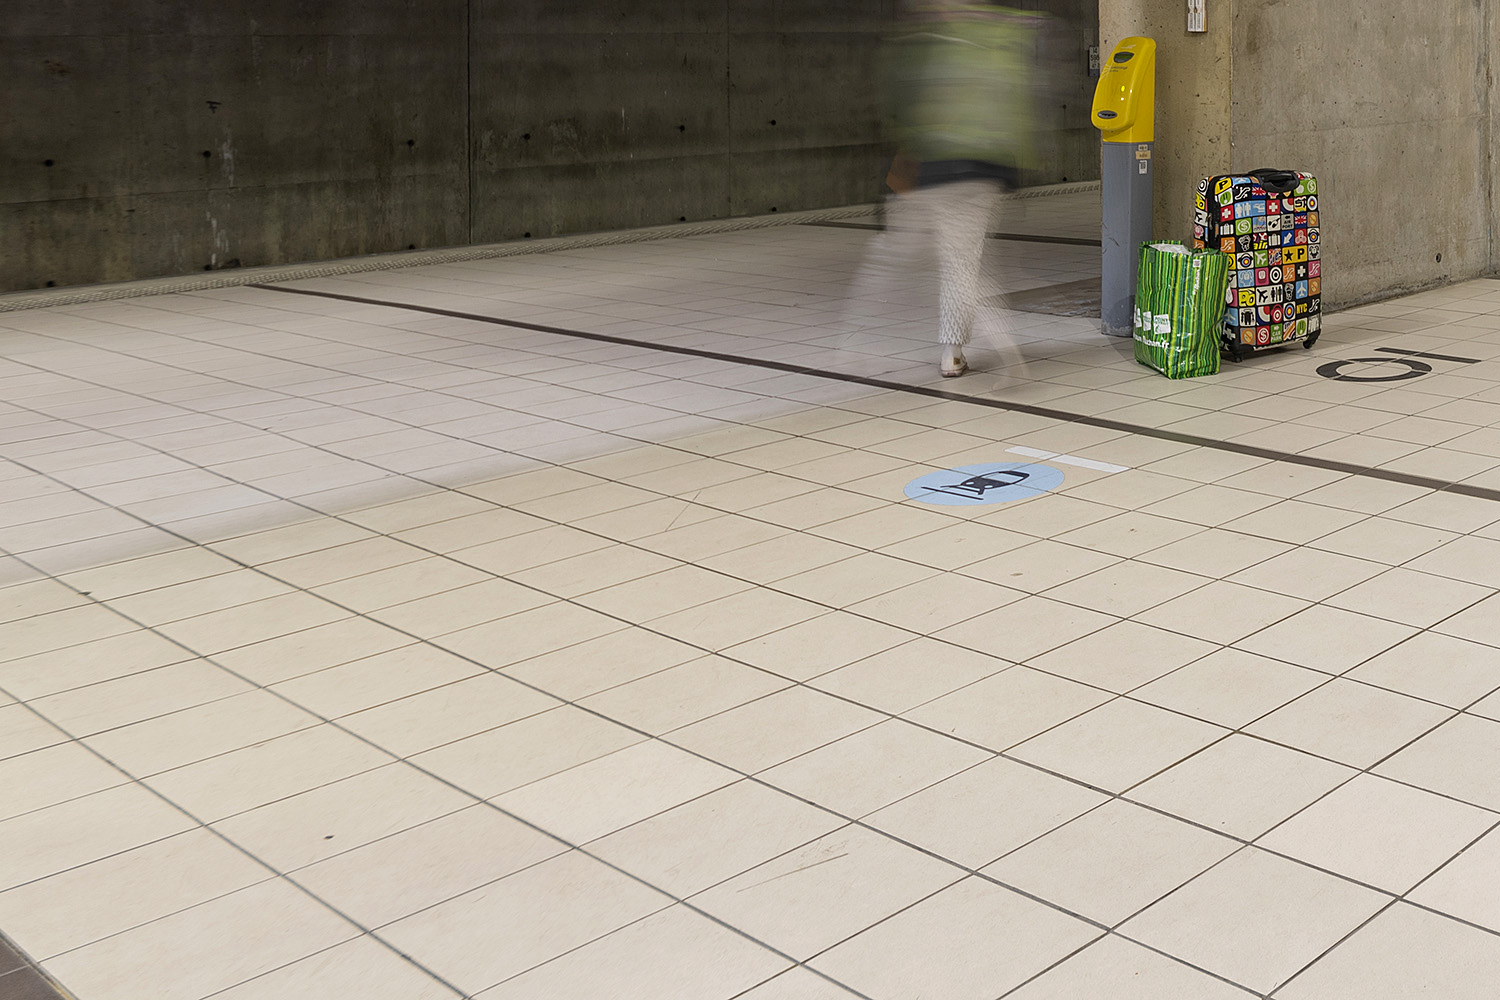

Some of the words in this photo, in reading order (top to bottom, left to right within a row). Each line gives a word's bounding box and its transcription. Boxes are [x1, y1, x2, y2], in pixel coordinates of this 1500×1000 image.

[1219, 180, 1228, 190] P
[1298, 248, 1304, 259] P
[1297, 303, 1307, 314] NYC
